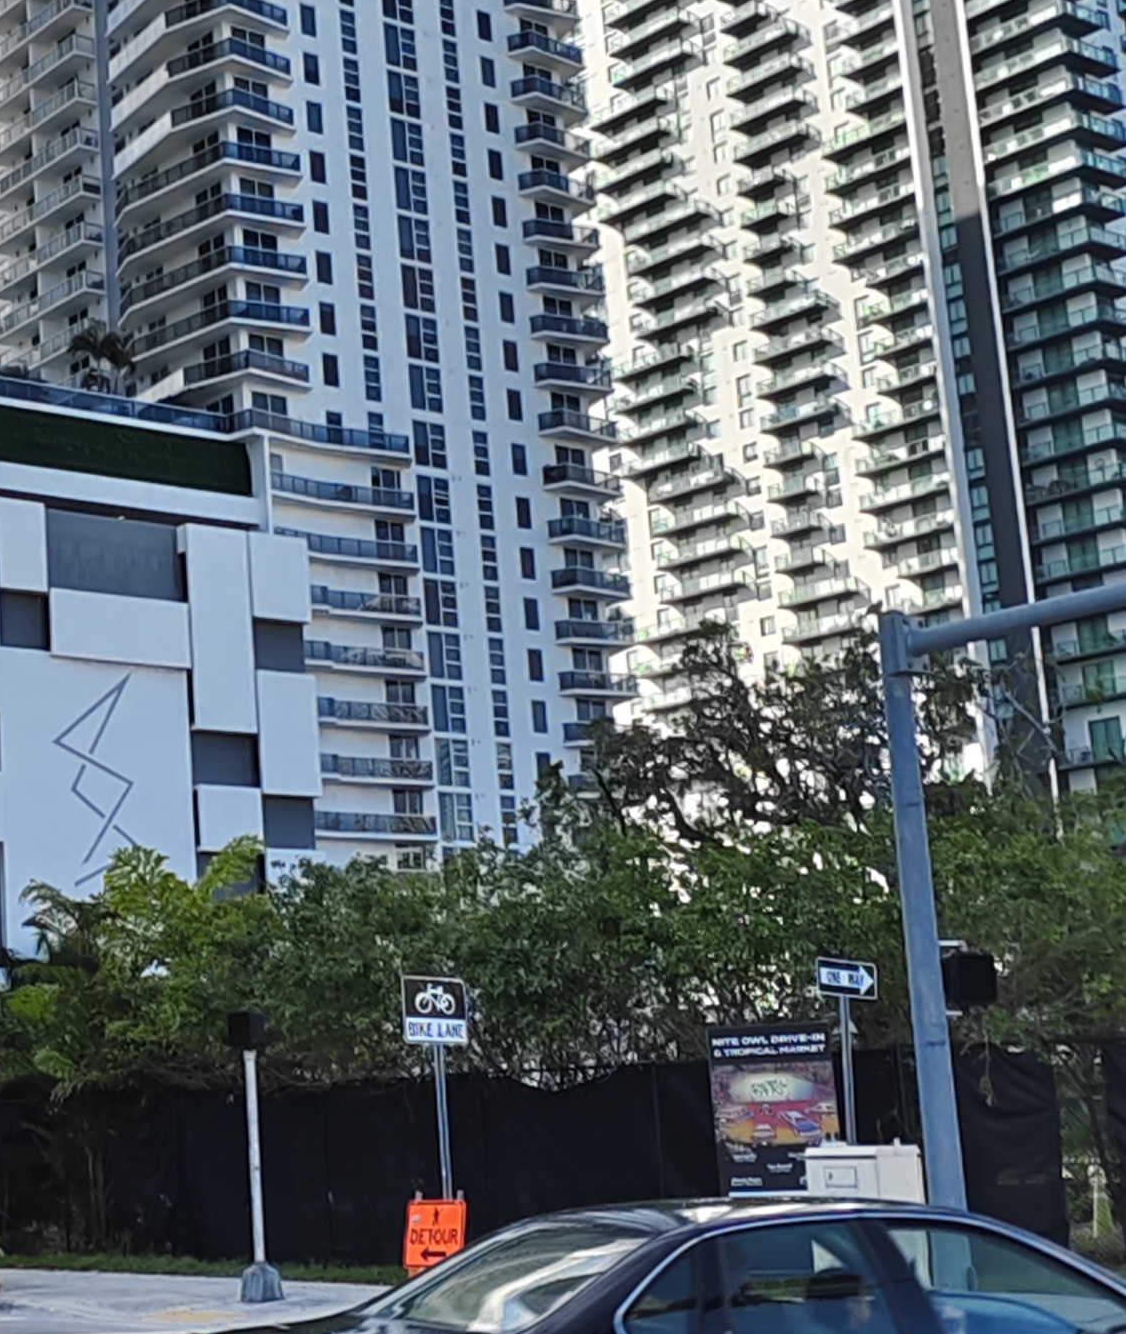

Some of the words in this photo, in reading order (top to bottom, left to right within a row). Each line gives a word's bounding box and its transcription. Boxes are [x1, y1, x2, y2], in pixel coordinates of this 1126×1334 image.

[408, 1021, 434, 1037] BIKE
[437, 1022, 464, 1039] LANE
[711, 1037, 740, 1047] NITE
[741, 1035, 769, 1046] OWL
[770, 1033, 826, 1044] DRIVE-IN
[723, 1046, 778, 1058] TROPICAL
[409, 1228, 459, 1246] DETOUR
